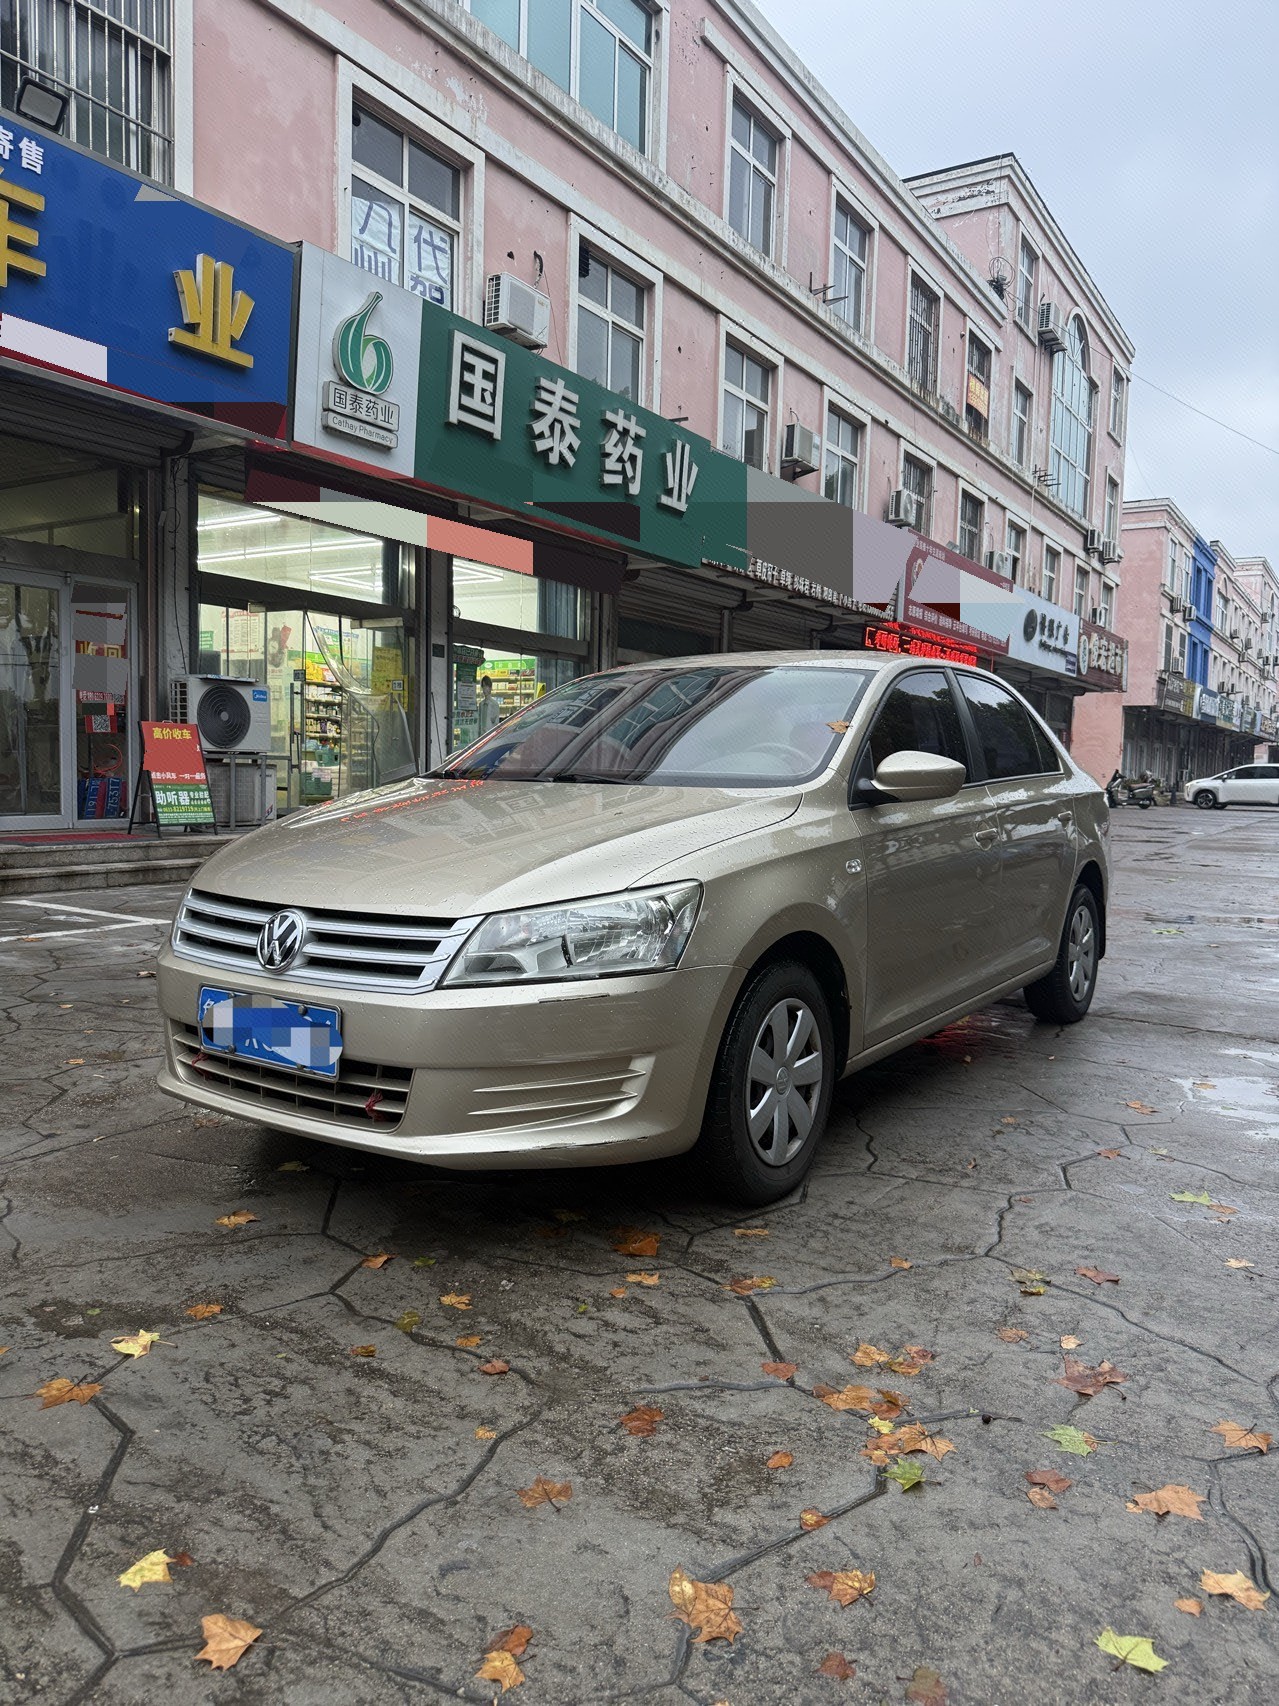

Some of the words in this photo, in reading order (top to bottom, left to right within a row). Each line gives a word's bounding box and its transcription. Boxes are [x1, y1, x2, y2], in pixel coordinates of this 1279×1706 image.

[333, 388, 394, 425] 国泰药业
[332, 416, 358, 433] Cathay
[358, 425, 393, 444] Pharmacy
[445, 329, 699, 518] 国泰药业
[152, 727, 192, 740] 高价收车
[155, 790, 190, 806] 助听器
